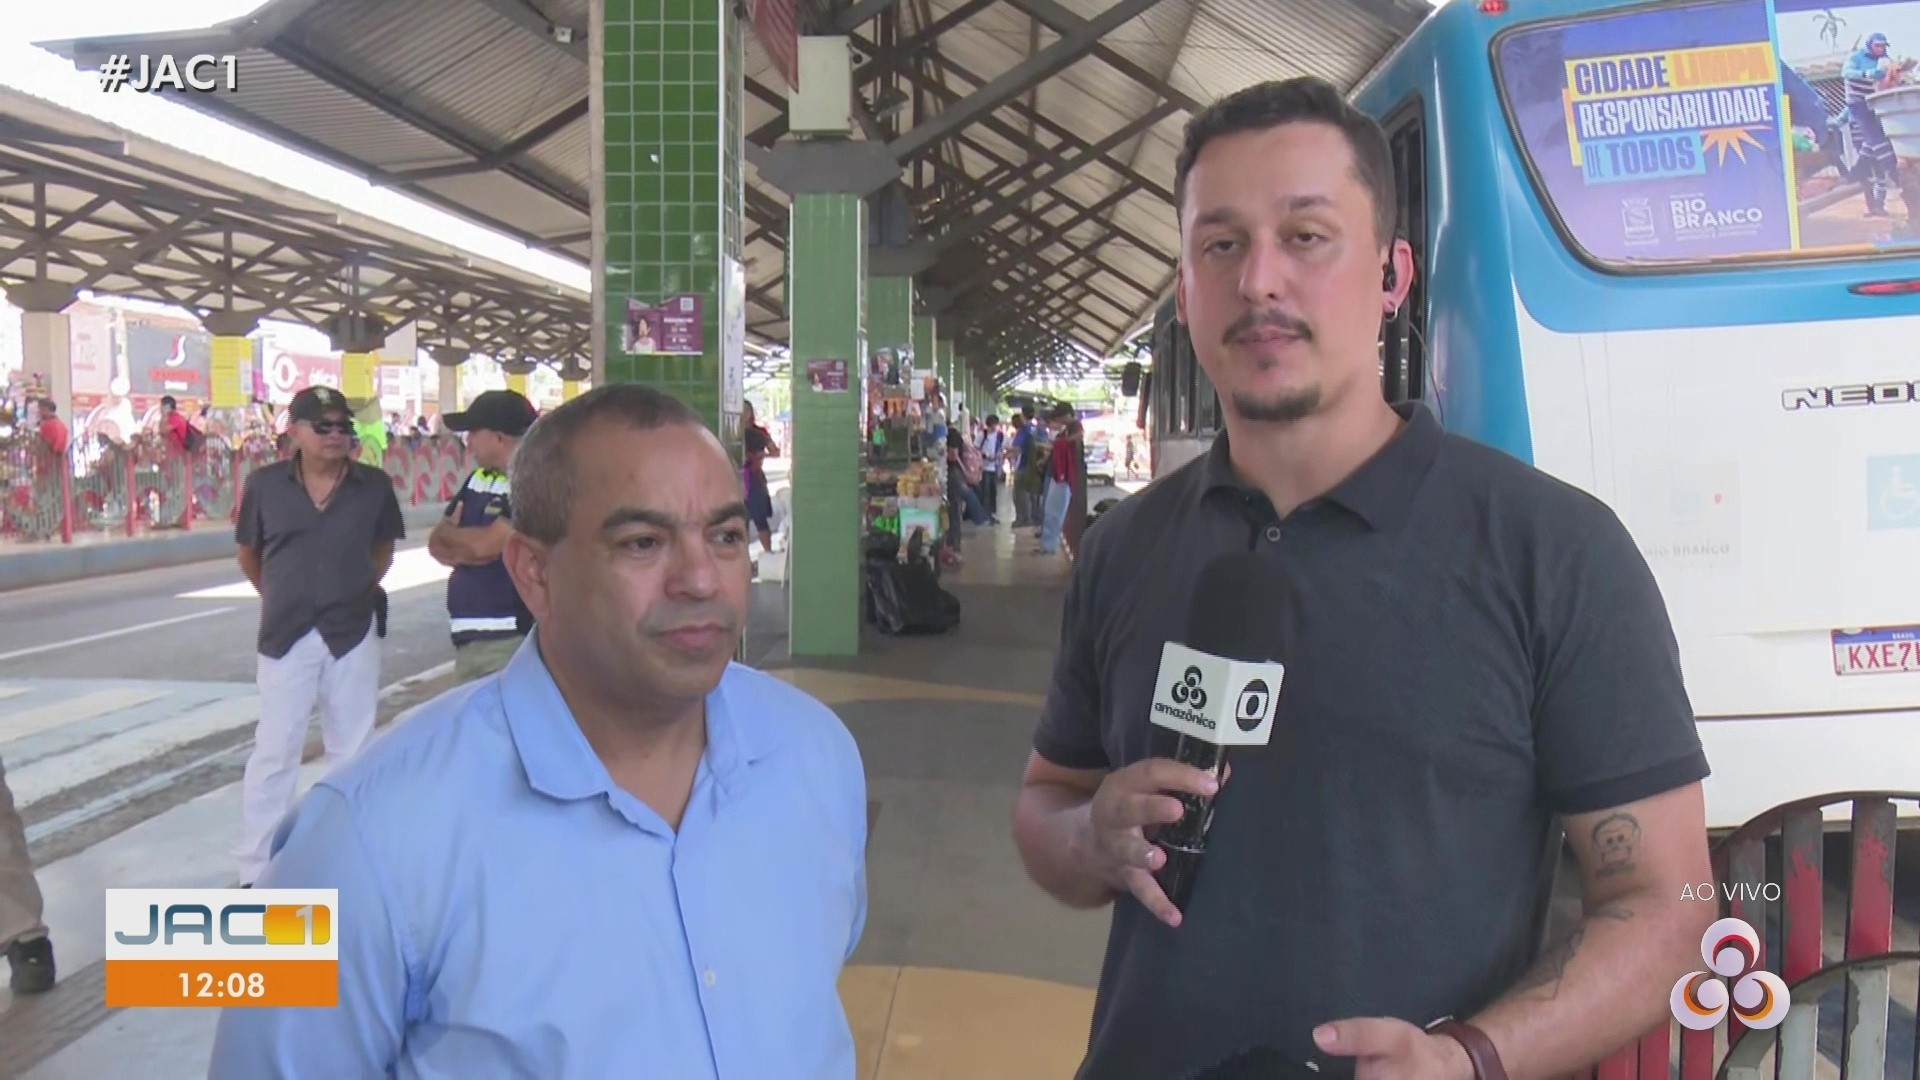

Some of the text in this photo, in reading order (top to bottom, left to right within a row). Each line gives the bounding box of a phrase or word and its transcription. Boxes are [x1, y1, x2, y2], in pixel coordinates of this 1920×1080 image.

[1574, 46, 1769, 95] CIDADE LIMPA
[1579, 87, 1773, 138] RESPONSABILIDADE
[1584, 136, 1696, 179] DE TODOS
[1670, 199, 1706, 214] RIO
[1672, 208, 1763, 229] BRANCO
[1781, 380, 1920, 411] NEO
[1154, 702, 1216, 730] amazônica
